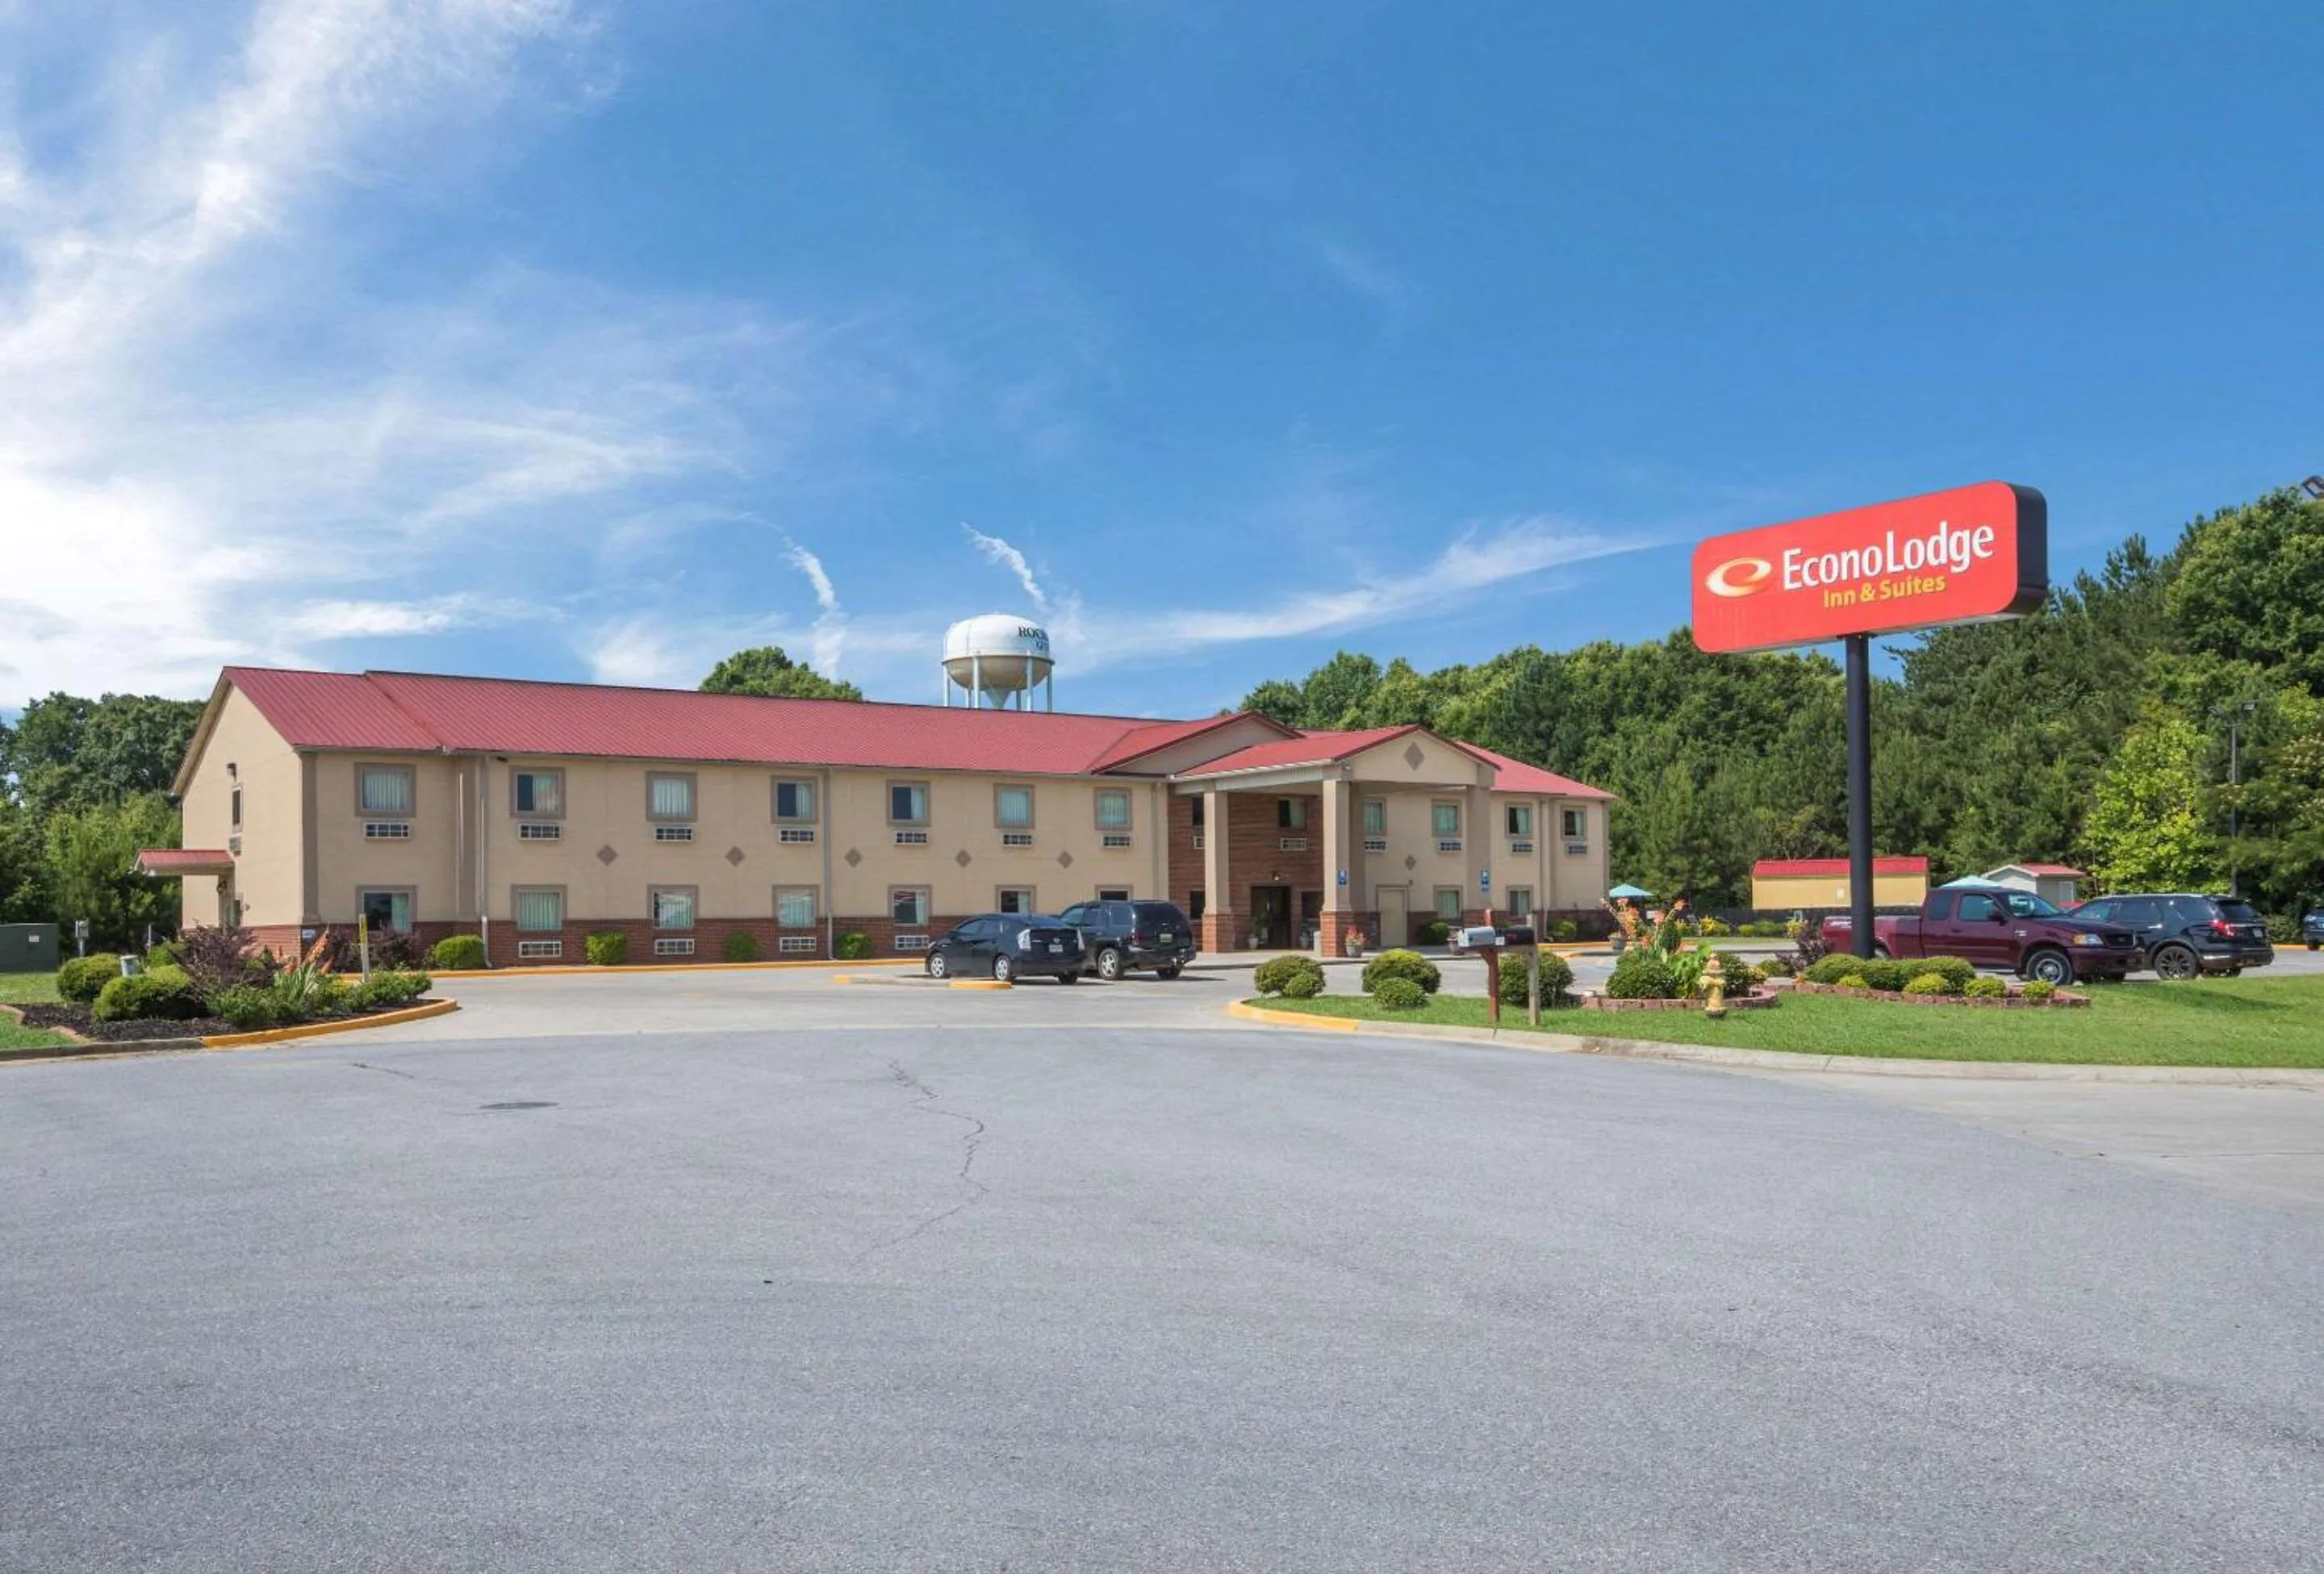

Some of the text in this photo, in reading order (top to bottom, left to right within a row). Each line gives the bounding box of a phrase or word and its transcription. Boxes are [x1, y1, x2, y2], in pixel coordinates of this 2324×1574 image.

[1824, 575, 1946, 607] Inn & Suites
